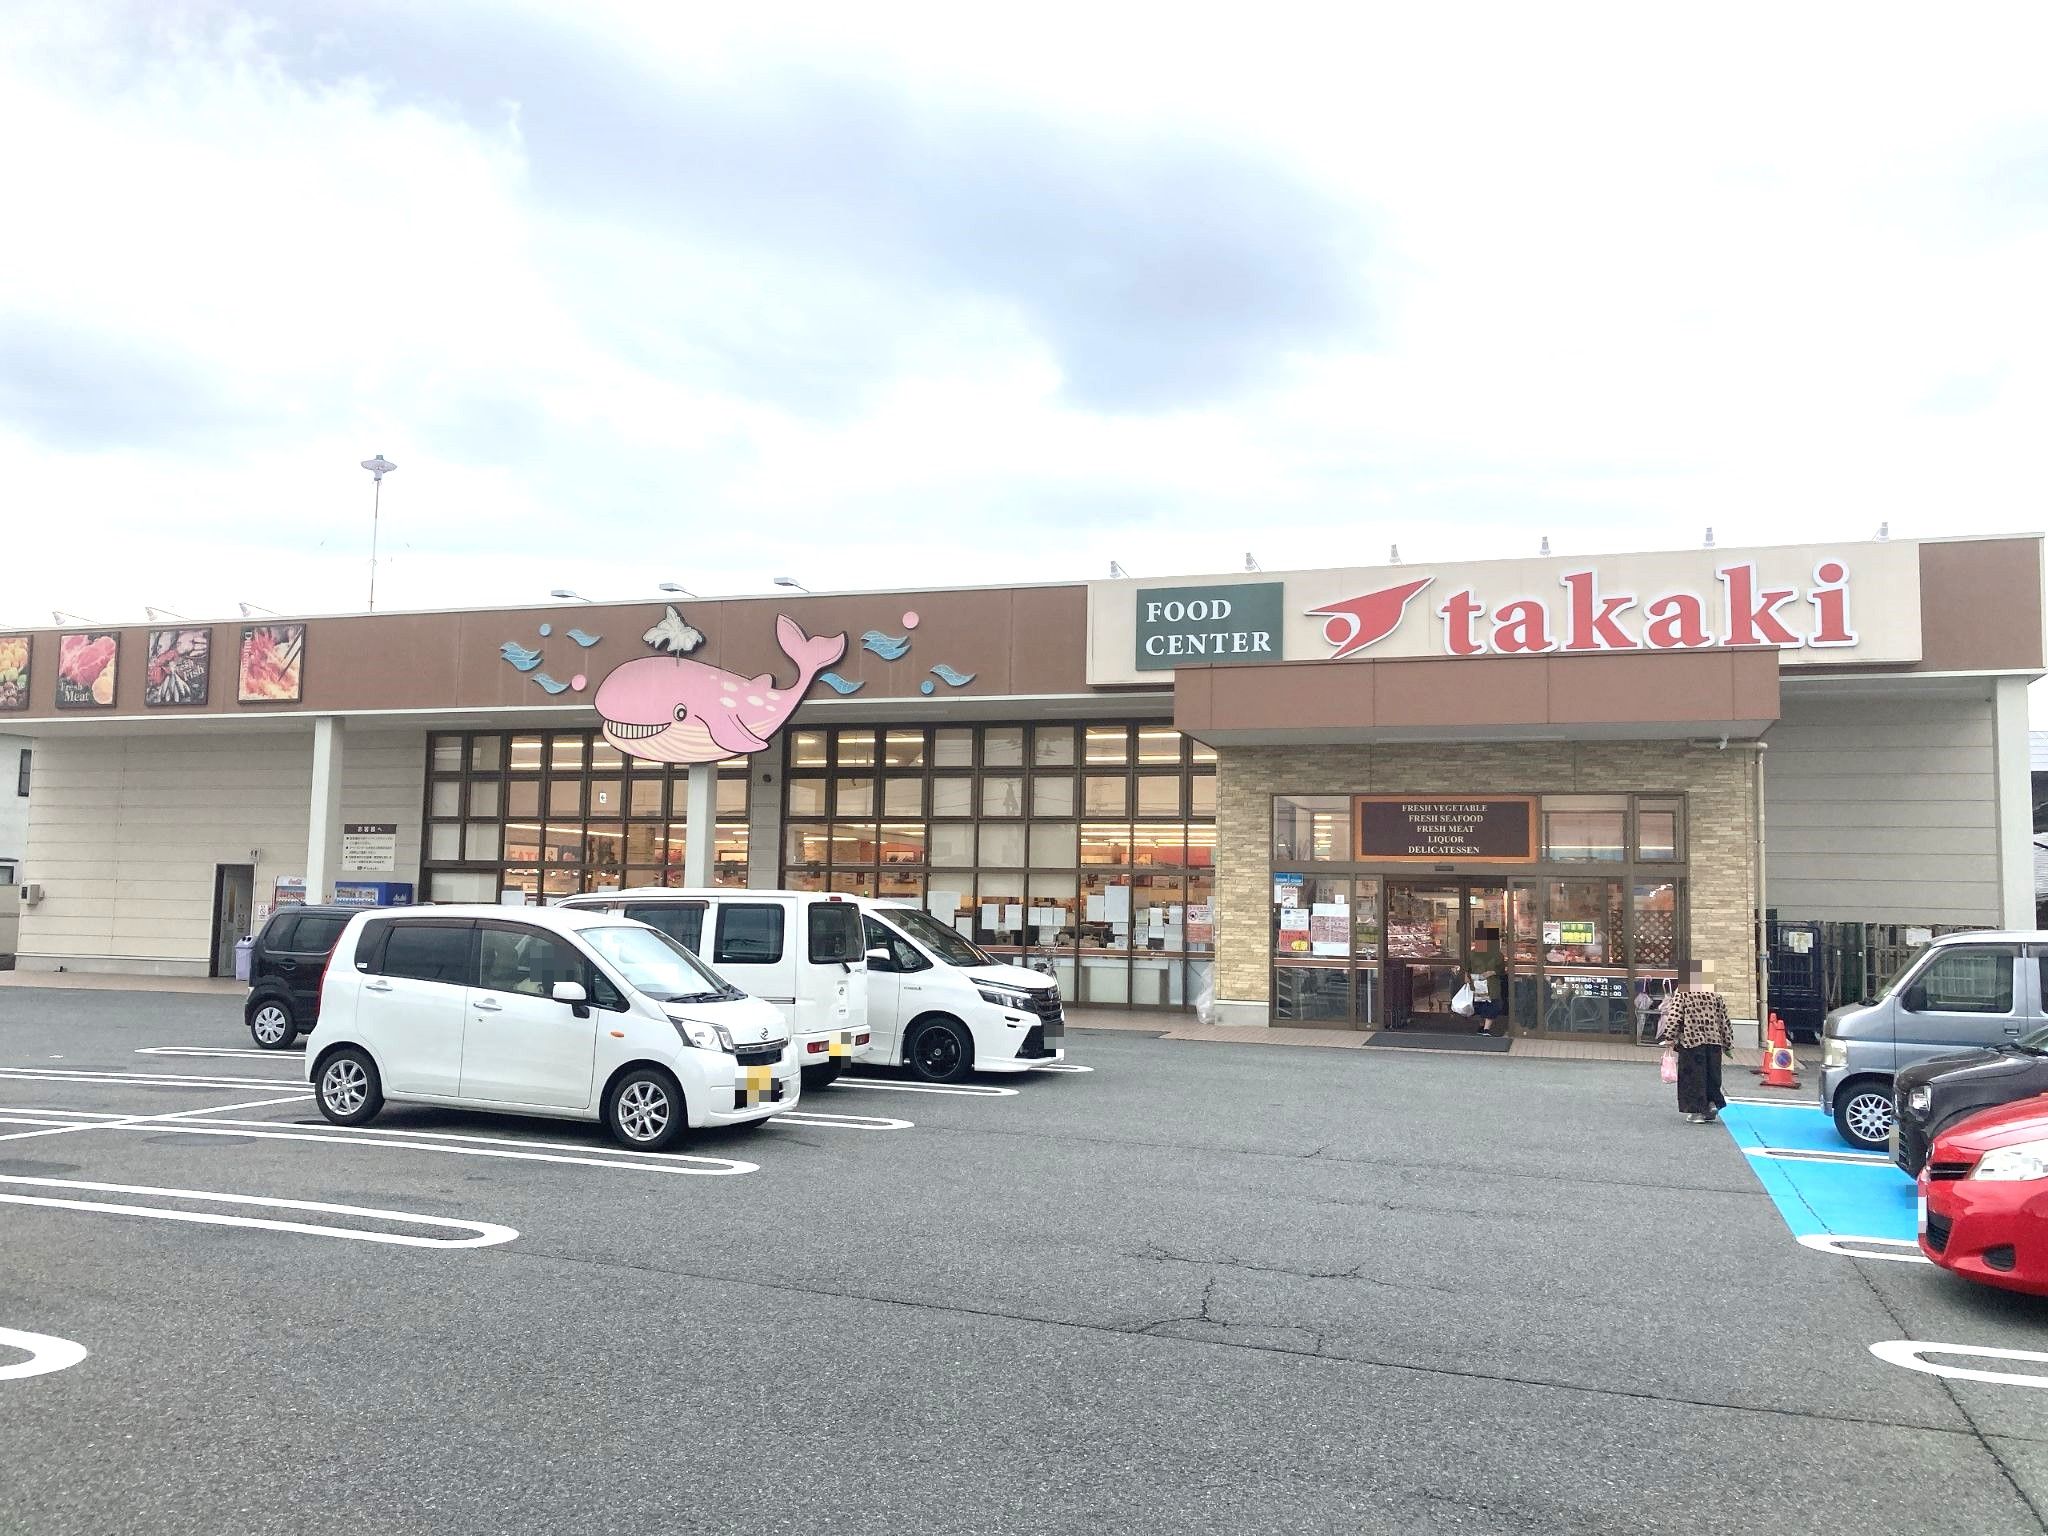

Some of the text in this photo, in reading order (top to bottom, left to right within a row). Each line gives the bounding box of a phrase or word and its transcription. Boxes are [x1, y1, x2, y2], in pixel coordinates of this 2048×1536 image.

[1146, 599, 1232, 623] FOOD
[1441, 562, 1856, 655] takaki
[1145, 631, 1272, 656] CENTER
[64, 690, 90, 702] Meat
[1402, 804, 1488, 812] FRESH VEGETABLE
[1408, 814, 1484, 822] FRESH SEAFOOD
[1416, 825, 1475, 833] FRESH MEAT
[1428, 836, 1464, 844] LIQUOR
[1408, 845, 1480, 854] DELICATESSEN
